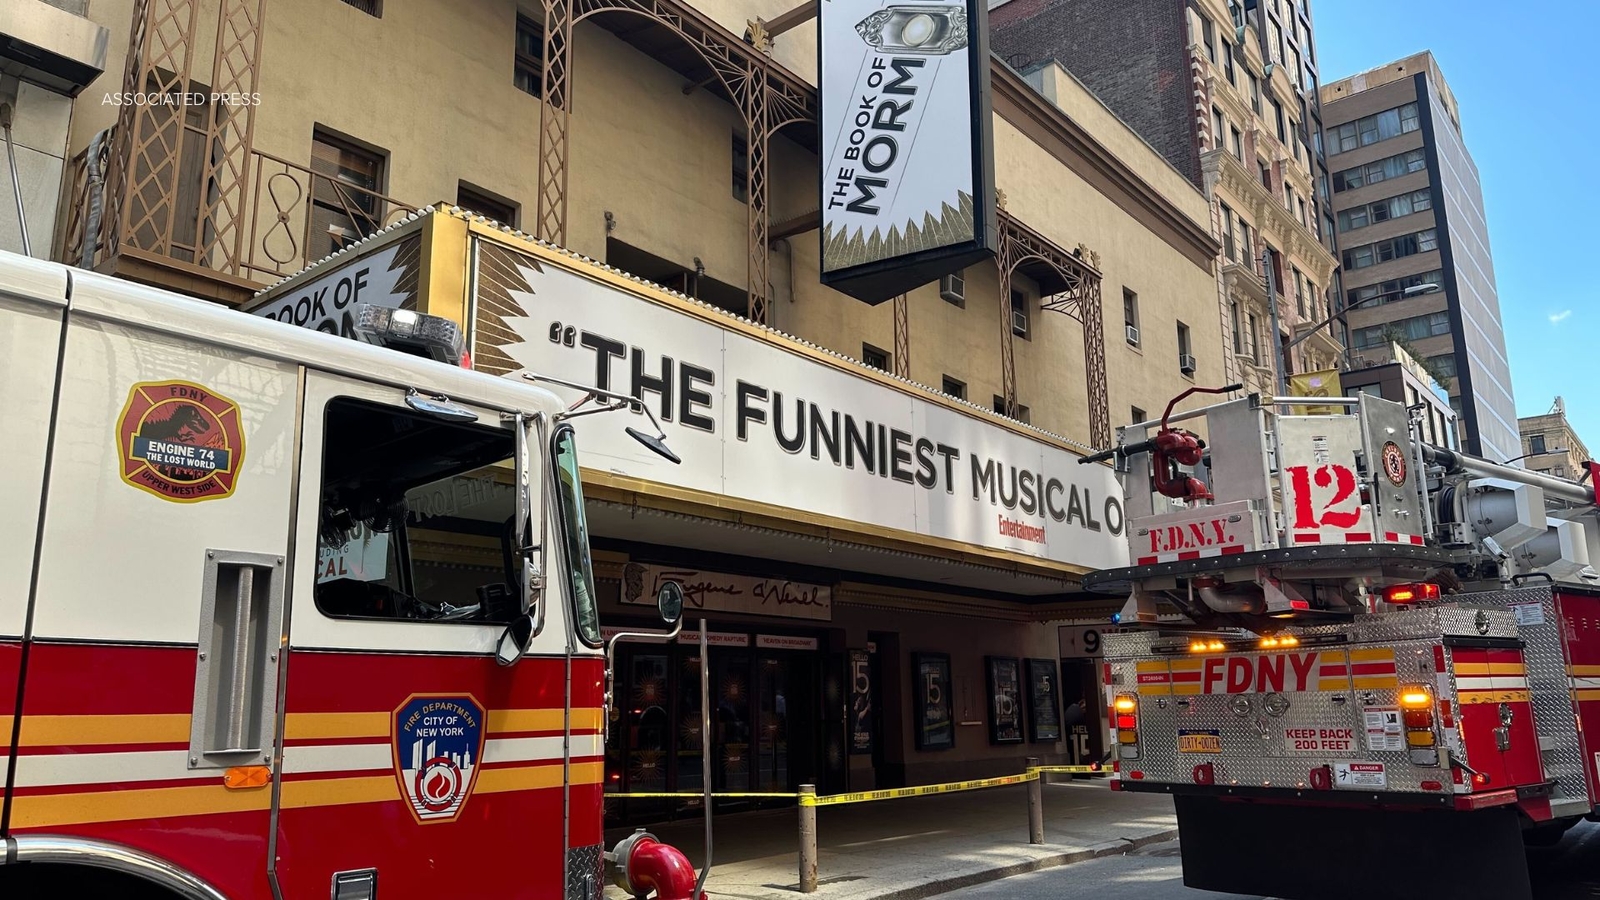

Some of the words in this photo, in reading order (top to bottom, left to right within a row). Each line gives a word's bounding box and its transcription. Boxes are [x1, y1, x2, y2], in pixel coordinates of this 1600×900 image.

[828, 167, 855, 210] THE
[844, 94, 877, 161] BOOK
[867, 57, 887, 89] OF
[265, 286, 329, 326] OOK
[333, 267, 370, 310] OF
[170, 386, 208, 402] FDNY
[146, 451, 162, 462] THE
[164, 454, 185, 466] LOST
[186, 458, 216, 470] WORLD
[148, 440, 195, 458] ENGINE
[199, 449, 215, 461] 74
[736, 378, 961, 495] FUNNIEST
[970, 452, 1102, 533] MUSICAL
[1104, 495, 1124, 537] O
[141, 470, 170, 492] UPPER
[171, 485, 196, 495] WEST
[198, 480, 217, 492] SIDE
[1285, 463, 1361, 530] 12
[998, 513, 1047, 545] Entertainment
[1149, 518, 1235, 553] F.D.N.Y.
[1083, 629, 1100, 654] 9
[852, 654, 869, 662] HELLO
[851, 661, 870, 694] 15
[1203, 652, 1319, 695] FDNY
[925, 673, 941, 704] 15
[403, 710, 421, 732] FIRE
[422, 702, 476, 729] DEPARTMENT
[423, 716, 444, 726] CITY
[445, 716, 458, 725] OF
[416, 728, 438, 737] NEW
[439, 727, 464, 737] YORK
[1285, 729, 1316, 738] KEEP
[1320, 729, 1353, 738] BACK
[1295, 740, 1318, 749] 200
[1321, 740, 1350, 749] FEET
